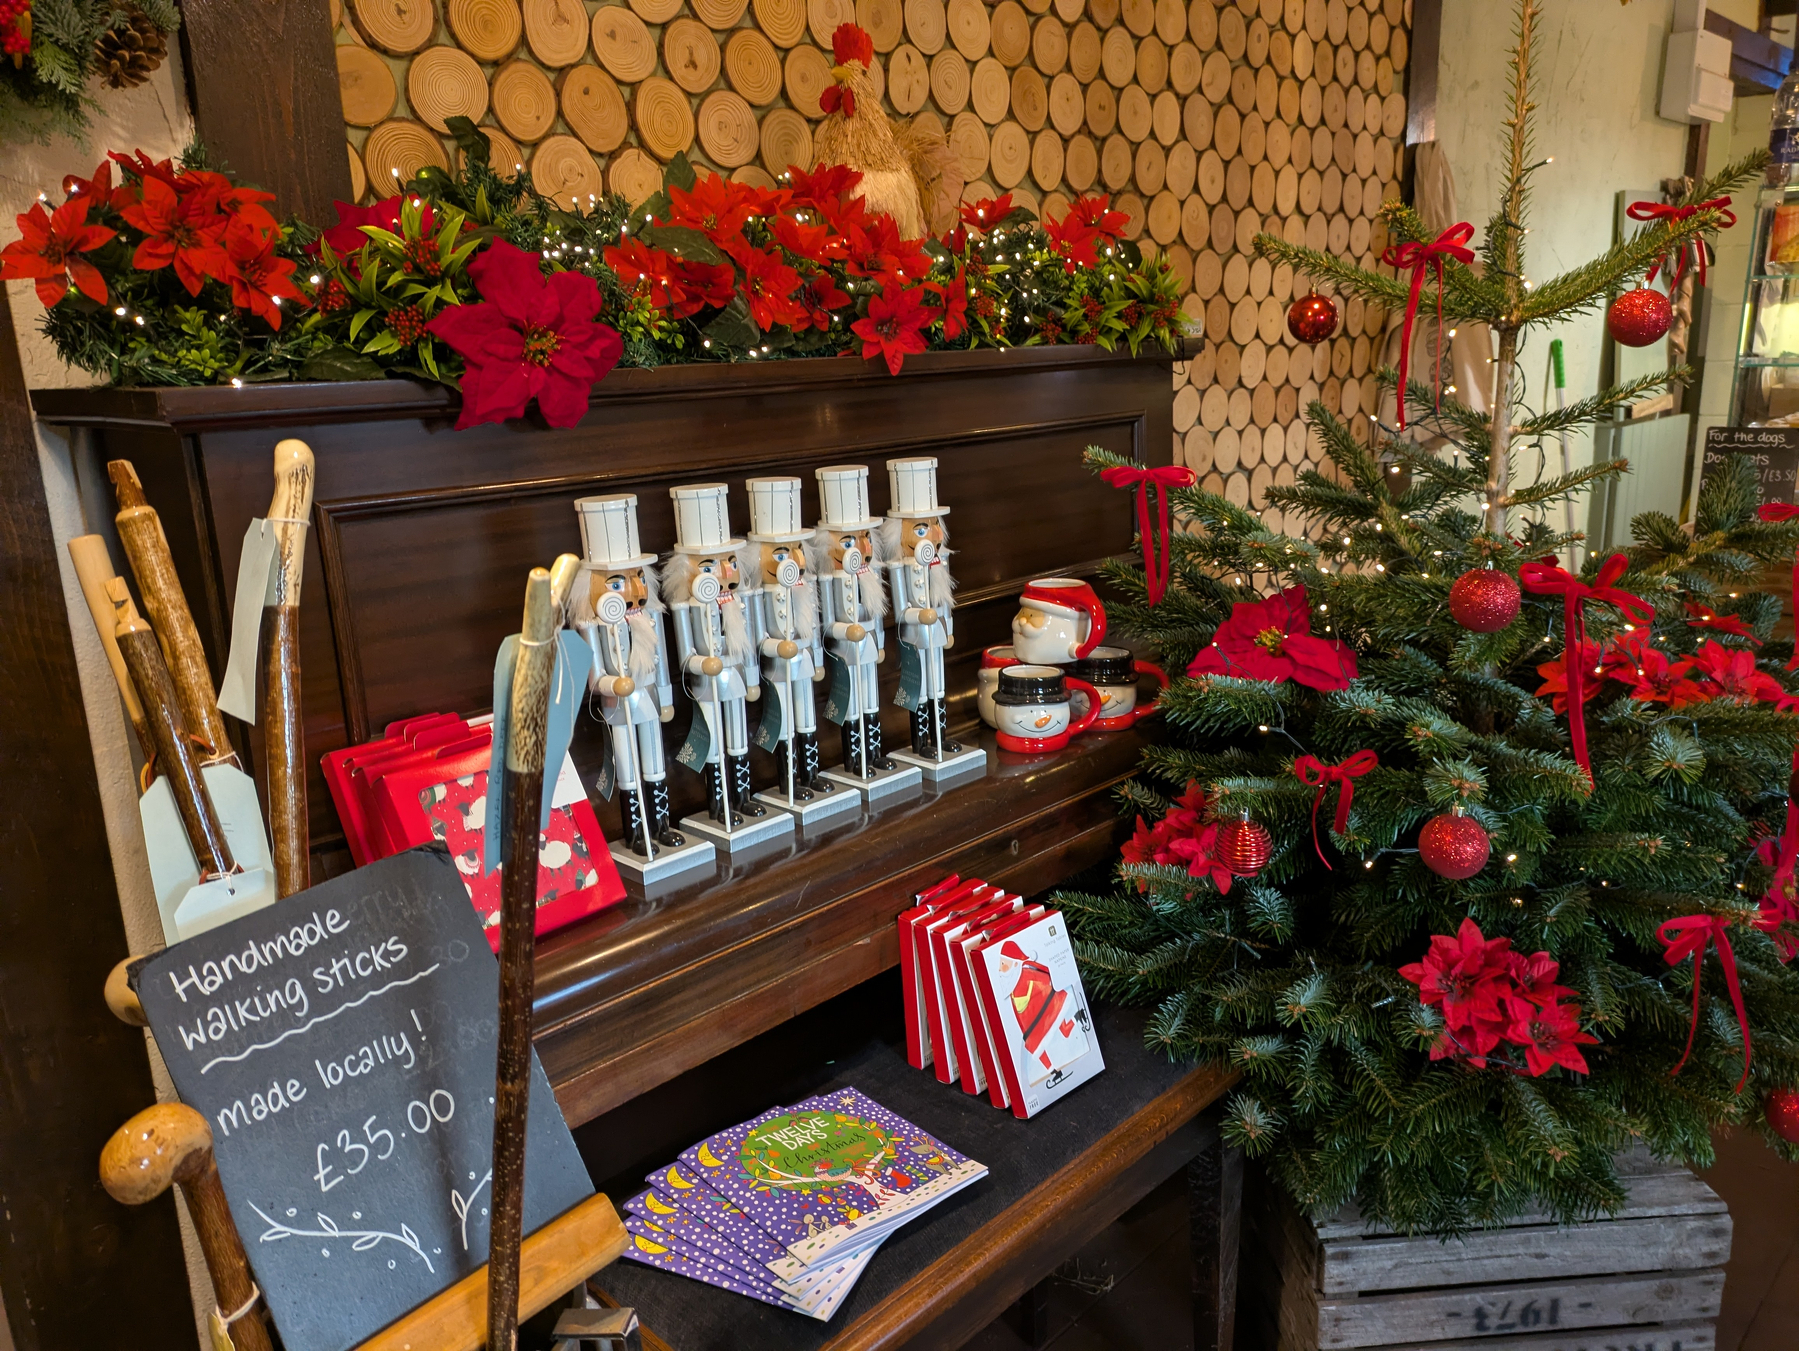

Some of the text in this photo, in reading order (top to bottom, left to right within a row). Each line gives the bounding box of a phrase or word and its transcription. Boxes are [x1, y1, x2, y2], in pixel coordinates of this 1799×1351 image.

[1709, 430, 1785, 447] For the dogs
[168, 907, 351, 1003] Handmade
[317, 935, 408, 996] sticks
[216, 1008, 428, 1136] made locally!
[313, 1089, 456, 1193] £35.00
[756, 1116, 830, 1146] TWELVE
[782, 1129, 828, 1151] DAYS
[784, 1132, 866, 1170] Christmas
[1473, 1297, 1561, 1332] 1973
